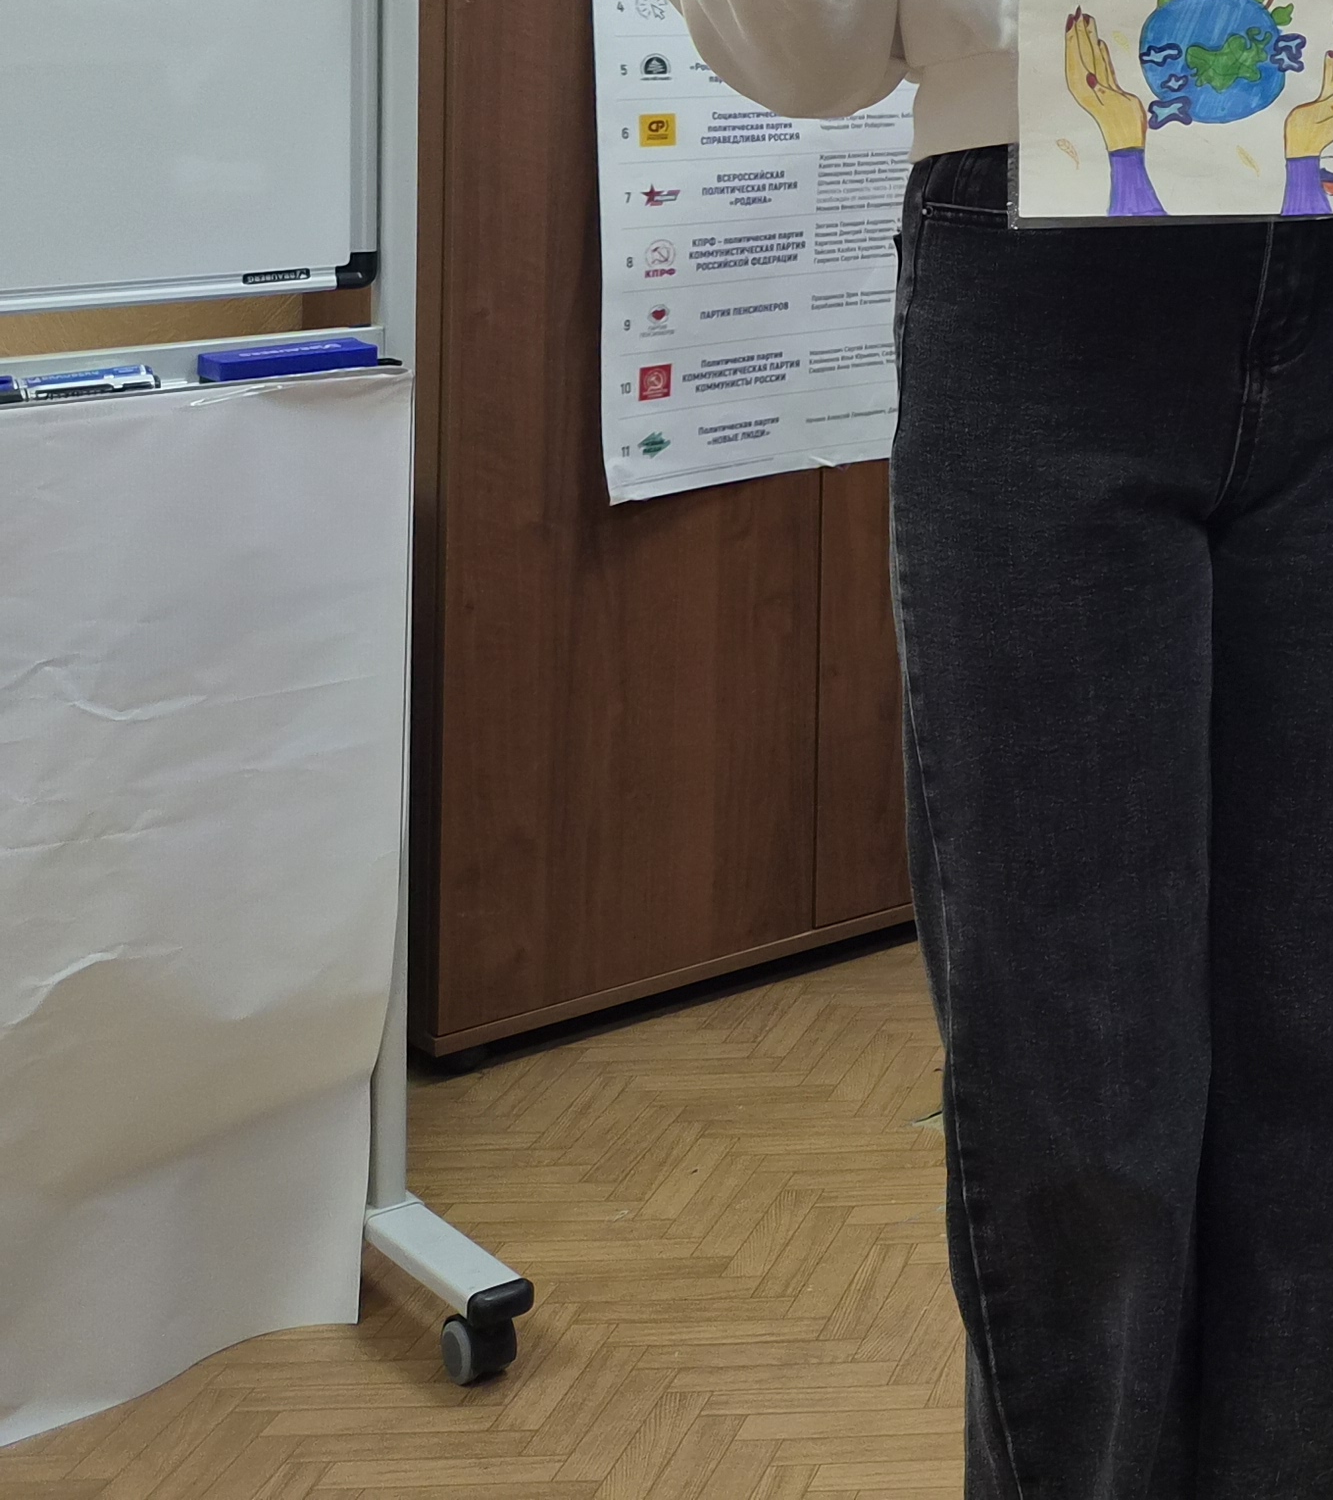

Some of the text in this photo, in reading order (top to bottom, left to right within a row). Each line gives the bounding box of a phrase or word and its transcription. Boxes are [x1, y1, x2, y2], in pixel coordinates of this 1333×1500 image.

[616, 1, 625, 12] 4
[620, 64, 628, 76] 5
[621, 127, 629, 140] 6
[708, 122, 792, 133] политическая партия
[700, 132, 800, 145] СПРАВЕДЛИВАЯ РОССИЯ
[716, 170, 785, 183] ВСЕРОССИЙСКАЯ
[702, 182, 798, 196] ПОЛИТИЧЕСКАЯ ПАРТИЯ
[624, 192, 631, 203] 7
[729, 196, 772, 206] «РОДИНА»
[692, 236, 716, 248] КПРФ
[723, 233, 776, 246] политическая
[777, 231, 804, 242] партия
[688, 241, 806, 260] КОММУНИСТИЧЕСКАЯ ПАРТИЯ
[626, 257, 634, 269] 8
[696, 253, 798, 272] РОССИЙСКОЙ ФЕДЕРАЦИИ
[644, 268, 676, 279] КПРФ
[700, 301, 789, 320] ПАРТИЯ ПЕНСИОНЕРОВ
[623, 319, 631, 331] 9
[701, 351, 783, 368] Политическая партия
[682, 359, 800, 383] КОММУНИСТИЧЕСКАЯ ПАРТИЯ
[620, 382, 632, 395] 10
[695, 373, 786, 393] КОММУНИСТЫ РОССИИ
[698, 416, 780, 436] Политическая партия
[706, 433, 739, 446] «НОВЫЕ
[621, 446, 631, 457] 11
